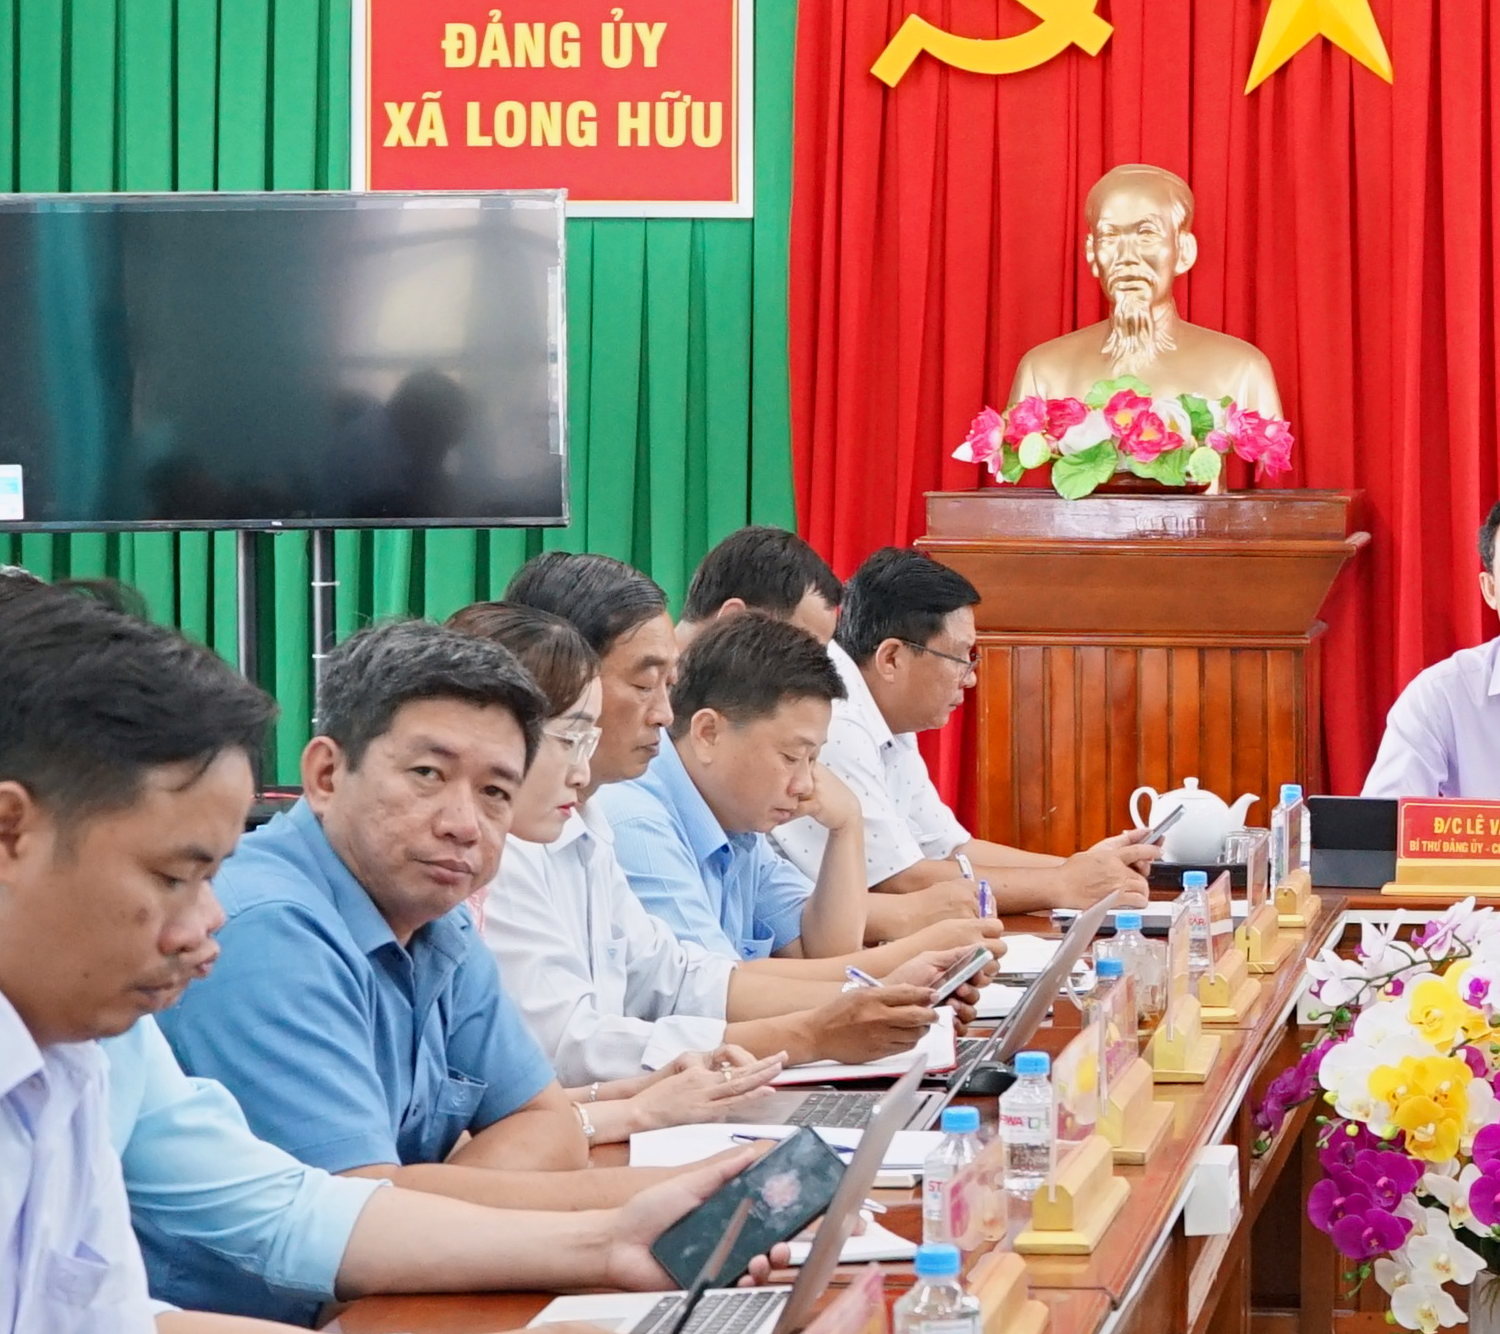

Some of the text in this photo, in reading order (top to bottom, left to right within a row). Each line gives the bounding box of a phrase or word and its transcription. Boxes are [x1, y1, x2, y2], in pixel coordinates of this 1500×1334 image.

[440, 7, 668, 69] ĐẢNG ỦY
[382, 90, 723, 148] XÃ LONG HỮU
[1434, 817, 1462, 835] Đ/C
[1466, 814, 1485, 836] LÊ
[1409, 838, 1419, 852] BÍ
[1421, 840, 1441, 852] THƯ
[1442, 839, 1469, 854] ĐẢNG
[1470, 839, 1484, 854] ỦY
